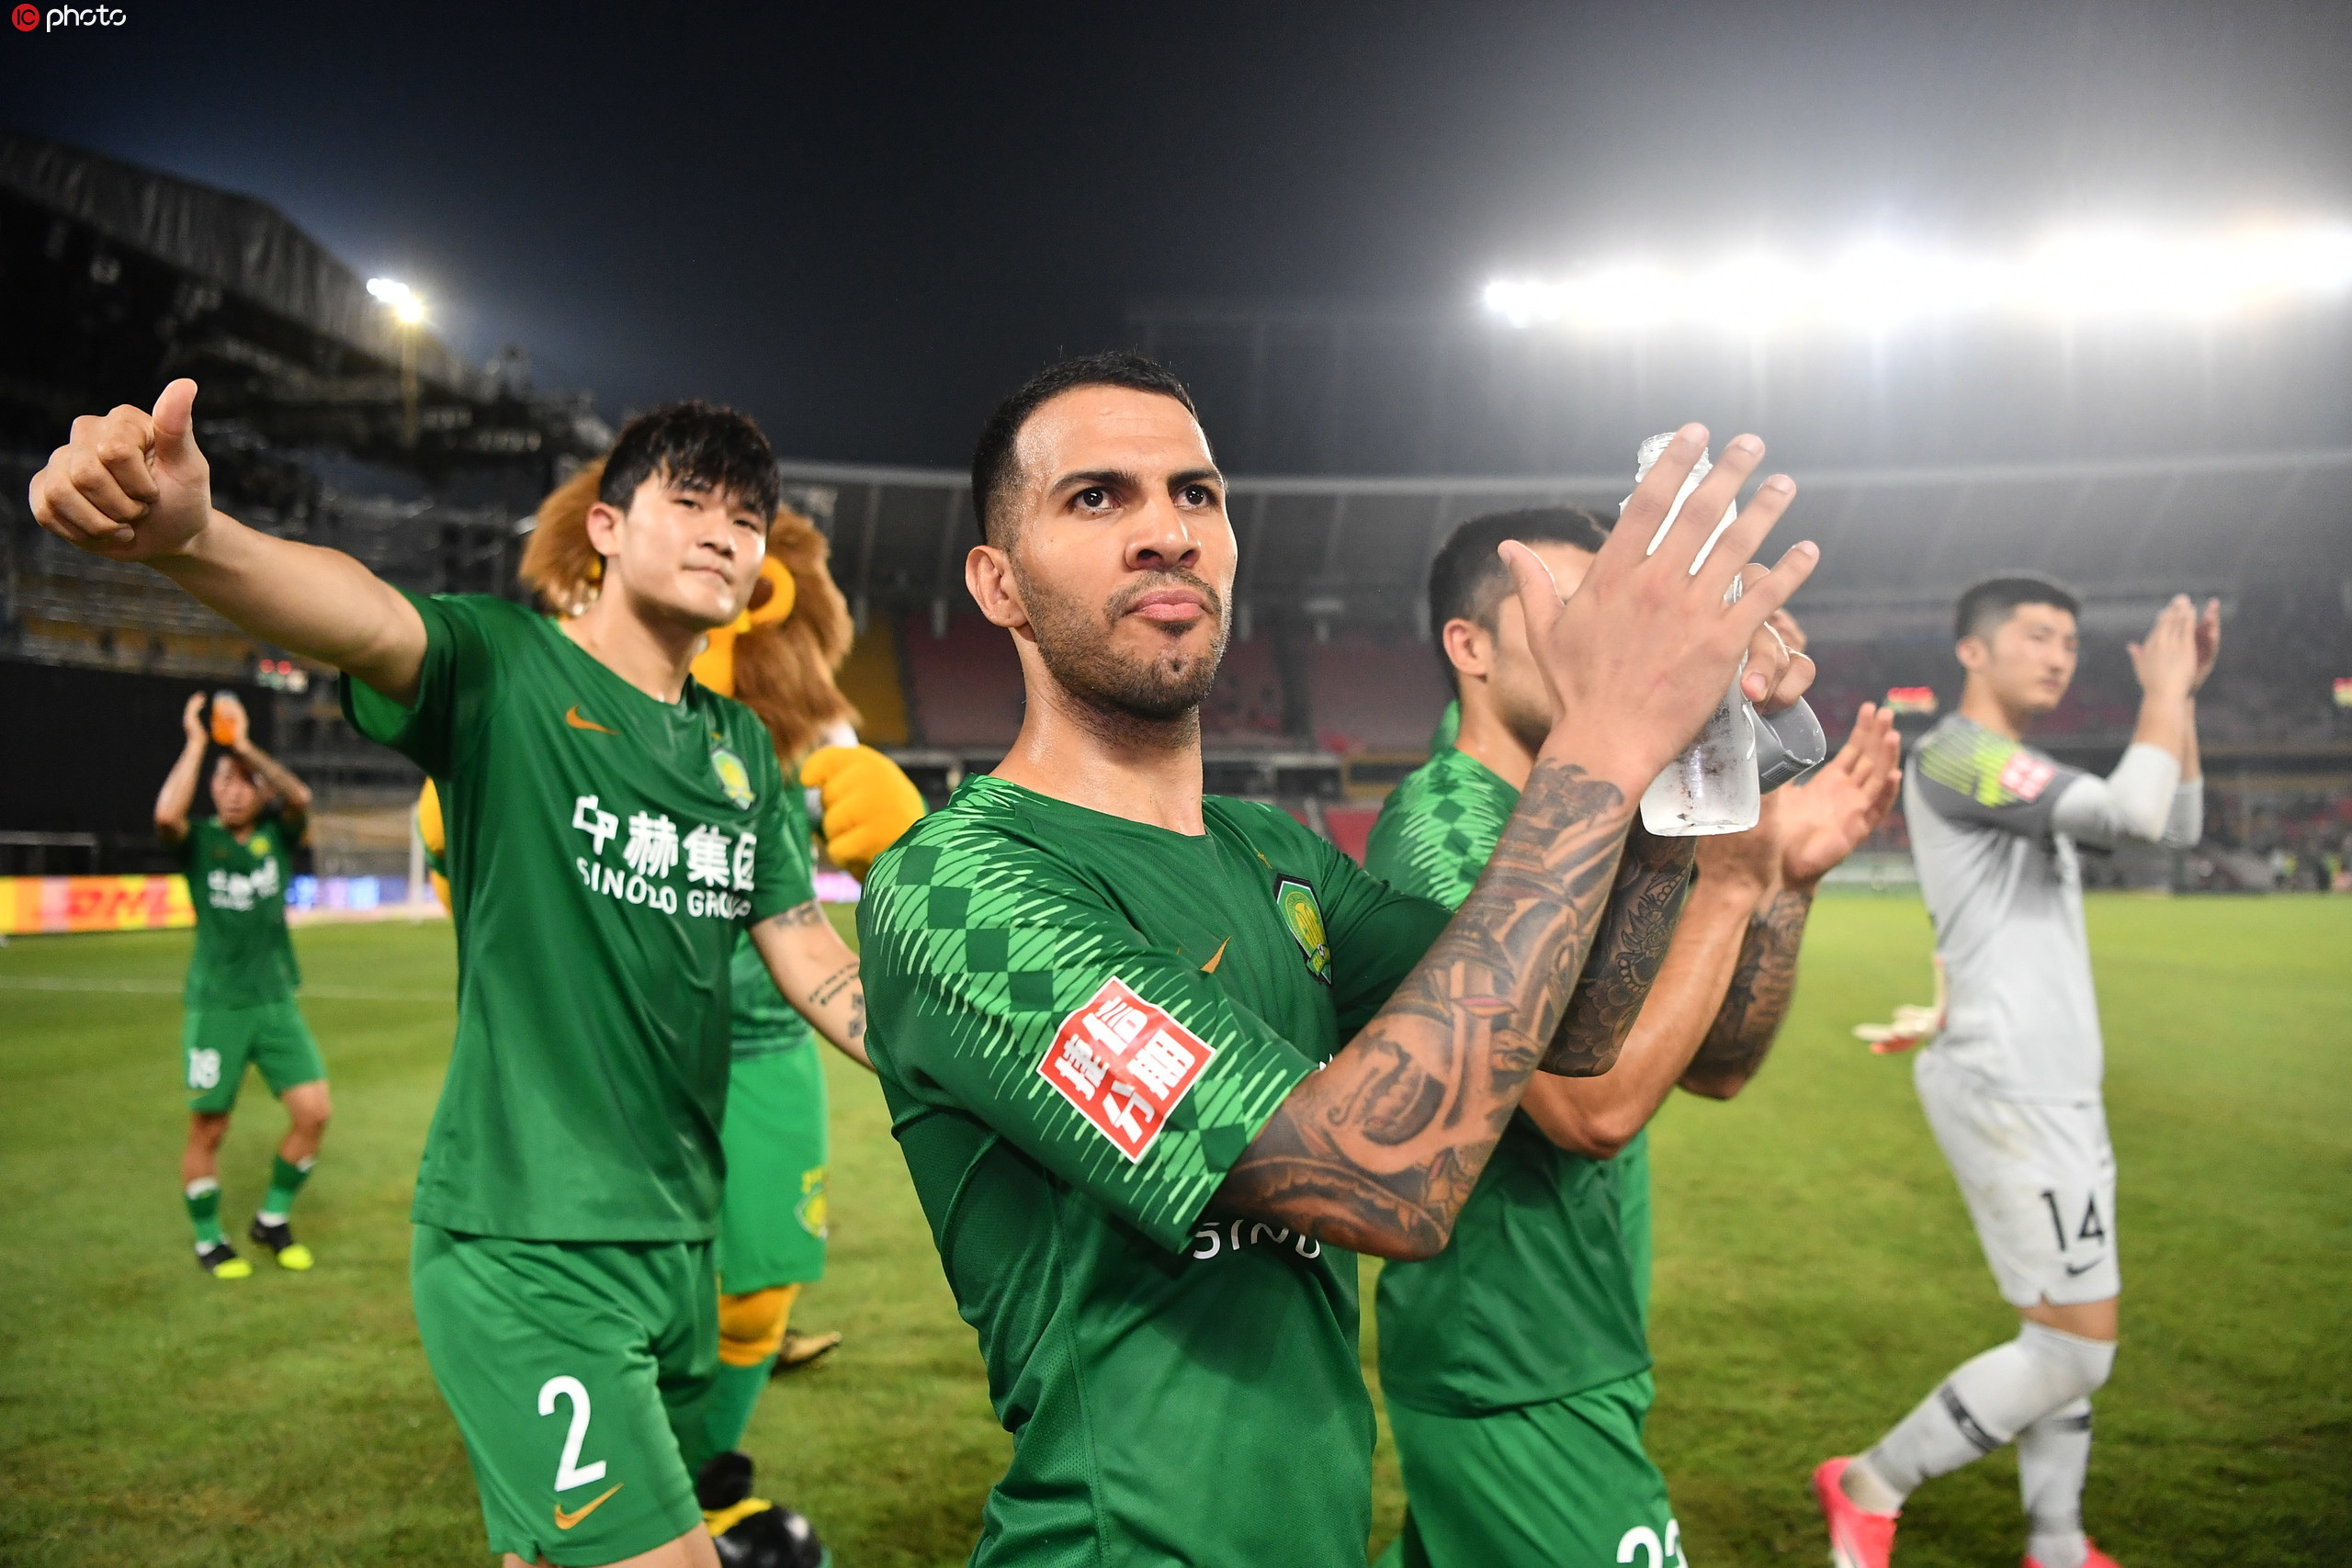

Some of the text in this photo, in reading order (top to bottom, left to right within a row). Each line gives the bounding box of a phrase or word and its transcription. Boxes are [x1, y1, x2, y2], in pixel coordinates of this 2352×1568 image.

[1054, 996, 1148, 1101] 捷信
[1102, 1029, 1195, 1144] 分期
[2039, 1190, 2105, 1251] 14
[537, 1375, 606, 1492] 2
